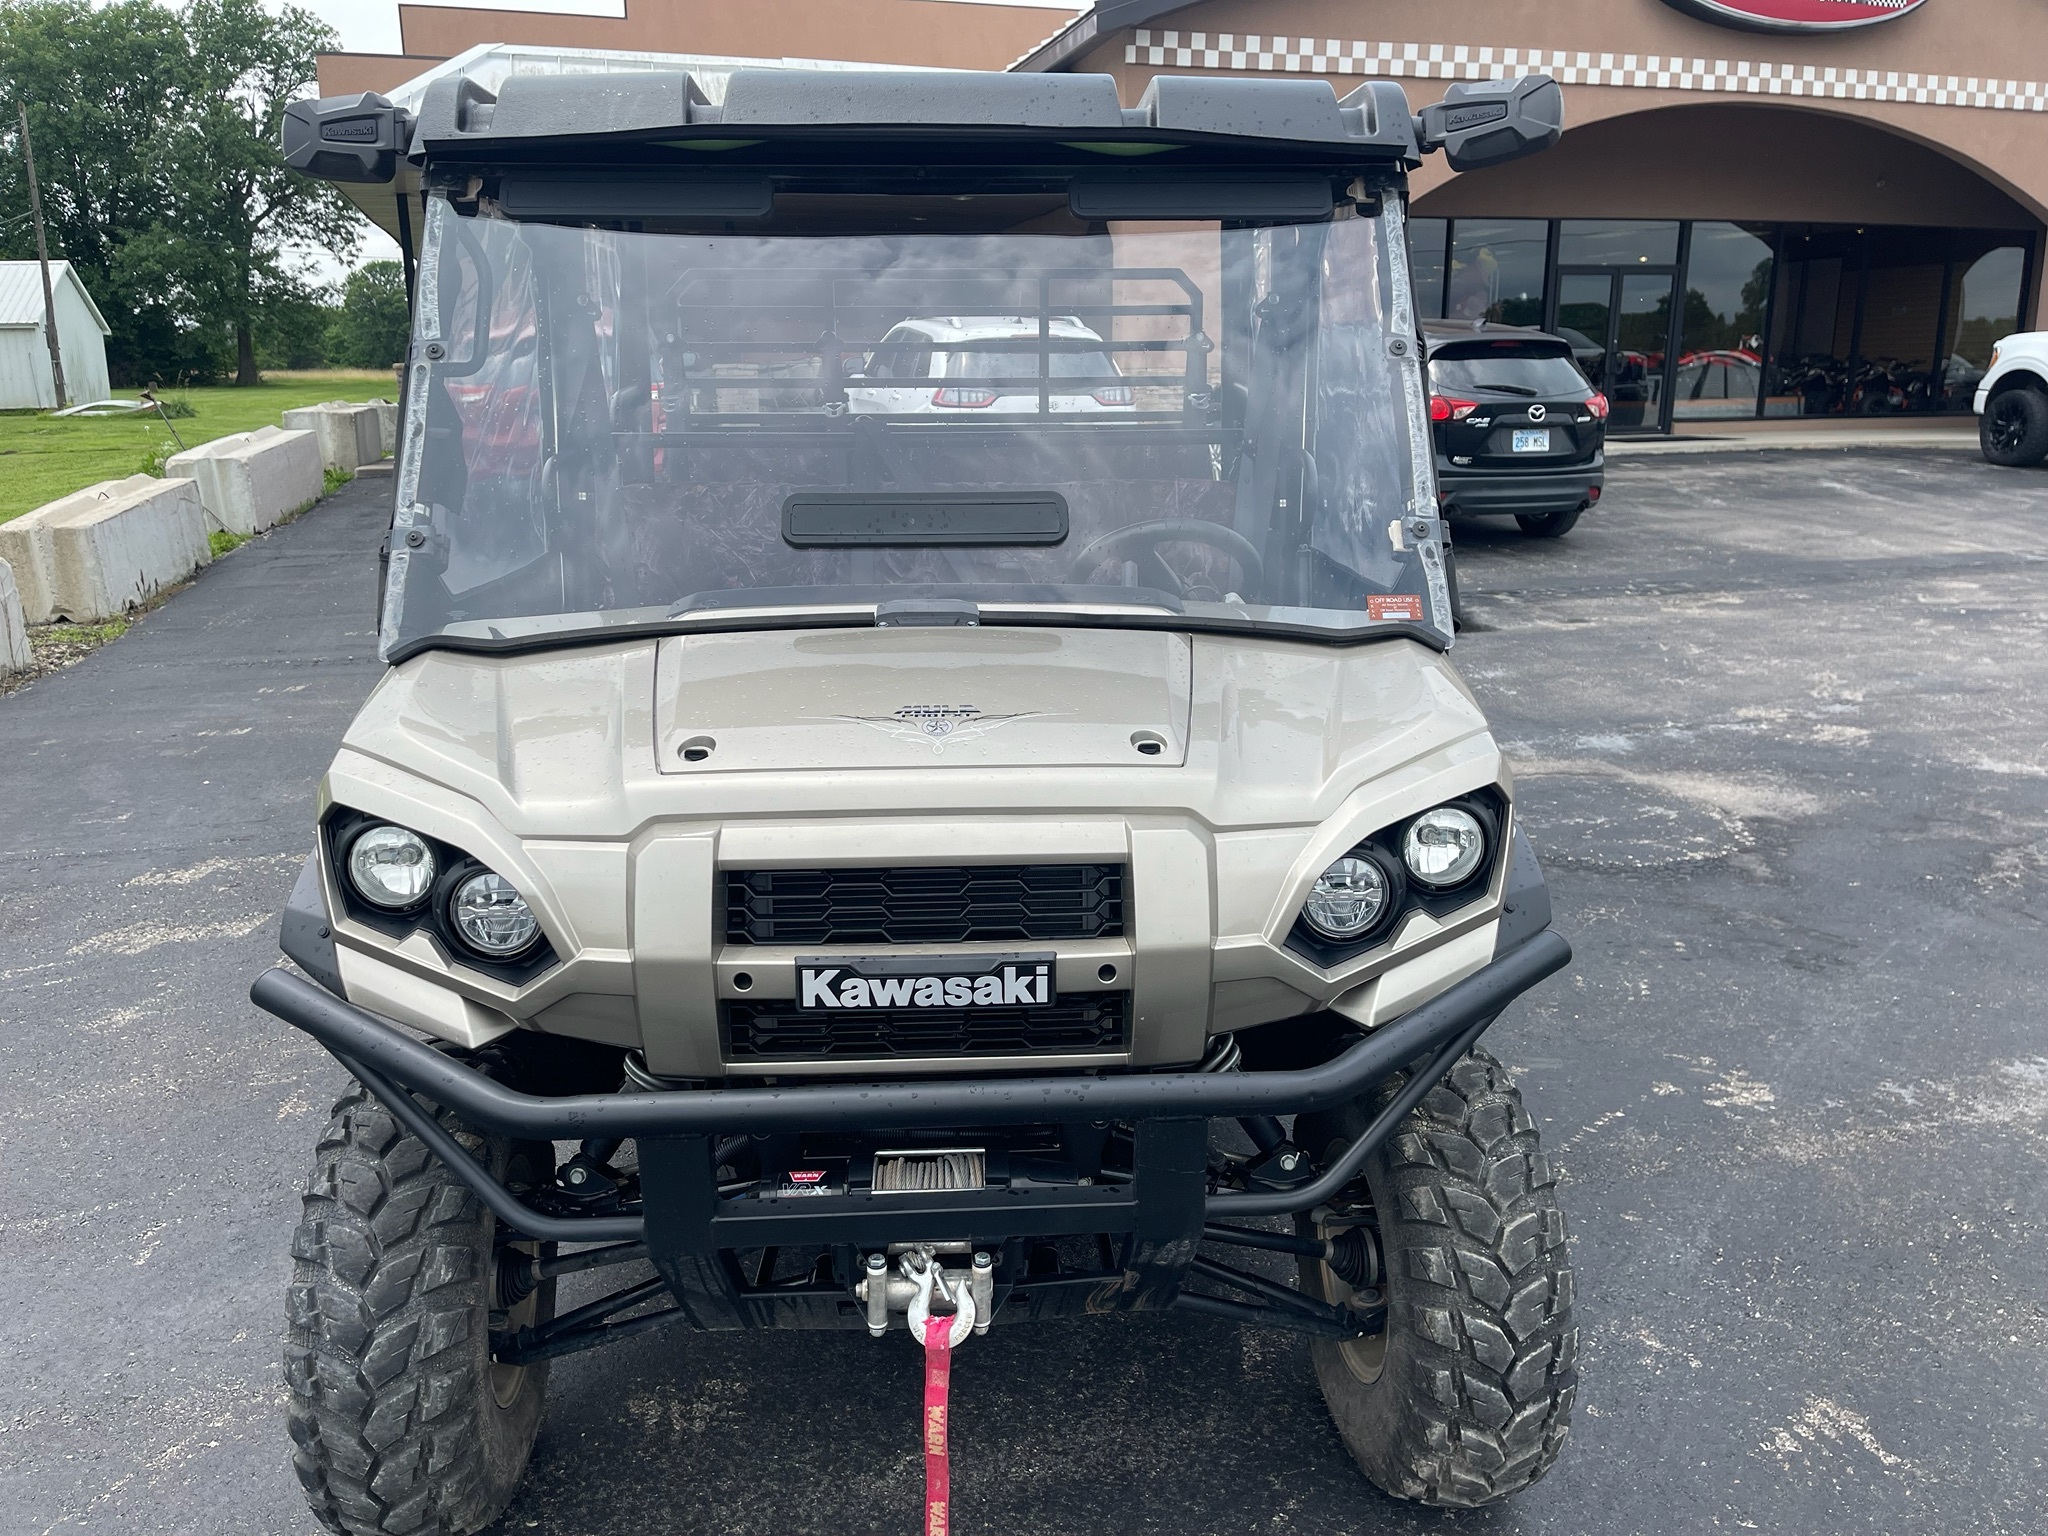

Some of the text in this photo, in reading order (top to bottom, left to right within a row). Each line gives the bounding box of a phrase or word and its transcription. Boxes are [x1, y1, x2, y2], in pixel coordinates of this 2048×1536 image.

[1450, 107, 1502, 124] Kawasaki
[324, 126, 373, 136] Kawasaki
[1515, 436, 1547, 448] 258 MSL
[802, 966, 1049, 1008] Kawasaki
[928, 1405, 945, 1456] WARN
[930, 1501, 946, 1536] WAR
